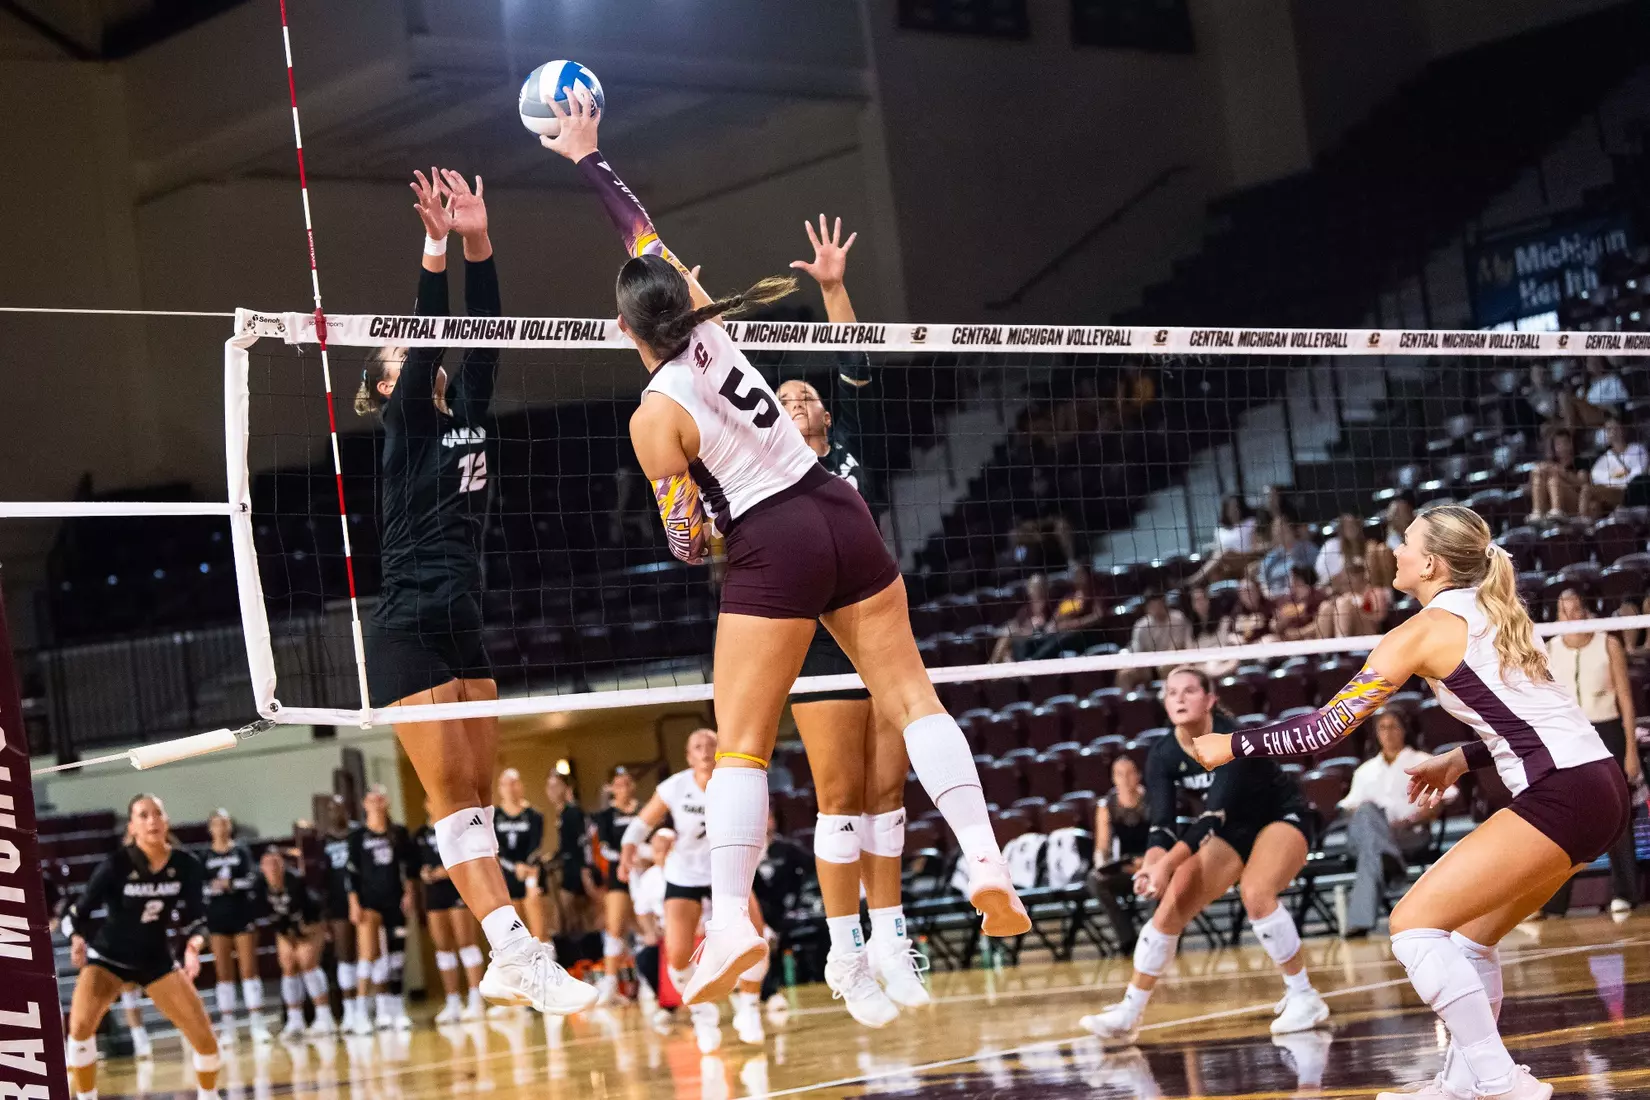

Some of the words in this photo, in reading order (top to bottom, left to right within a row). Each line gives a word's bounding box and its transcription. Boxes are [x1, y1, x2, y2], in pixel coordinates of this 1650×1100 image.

[259, 316, 281, 324] Senoh
[369, 317, 437, 340] CENTRAL
[441, 318, 516, 341] MICHIGAN
[520, 320, 606, 341] VOLLEYBALL
[743, 325, 808, 343] MICHIGAN
[811, 326, 886, 344] VOLLEYBALL
[952, 327, 1003, 345] CENTRAL
[1006, 328, 1063, 346] MICHIGAN
[1066, 329, 1132, 347] VOLLEYBALL
[1189, 330, 1234, 347] CENTRAL
[1237, 331, 1288, 348] MICHIGAN
[1290, 332, 1348, 348] VOLLEYBALL
[1399, 333, 1439, 348] CENTRAL
[1441, 334, 1487, 349] MICHIGAN
[1488, 334, 1540, 349] VOLLEYBALL
[1585, 334, 1621, 349] CENTRAL
[718, 366, 780, 429] 5
[458, 451, 487, 493] 12
[1263, 700, 1356, 755] CHIPPEWAS
[140, 899, 165, 924] 2
